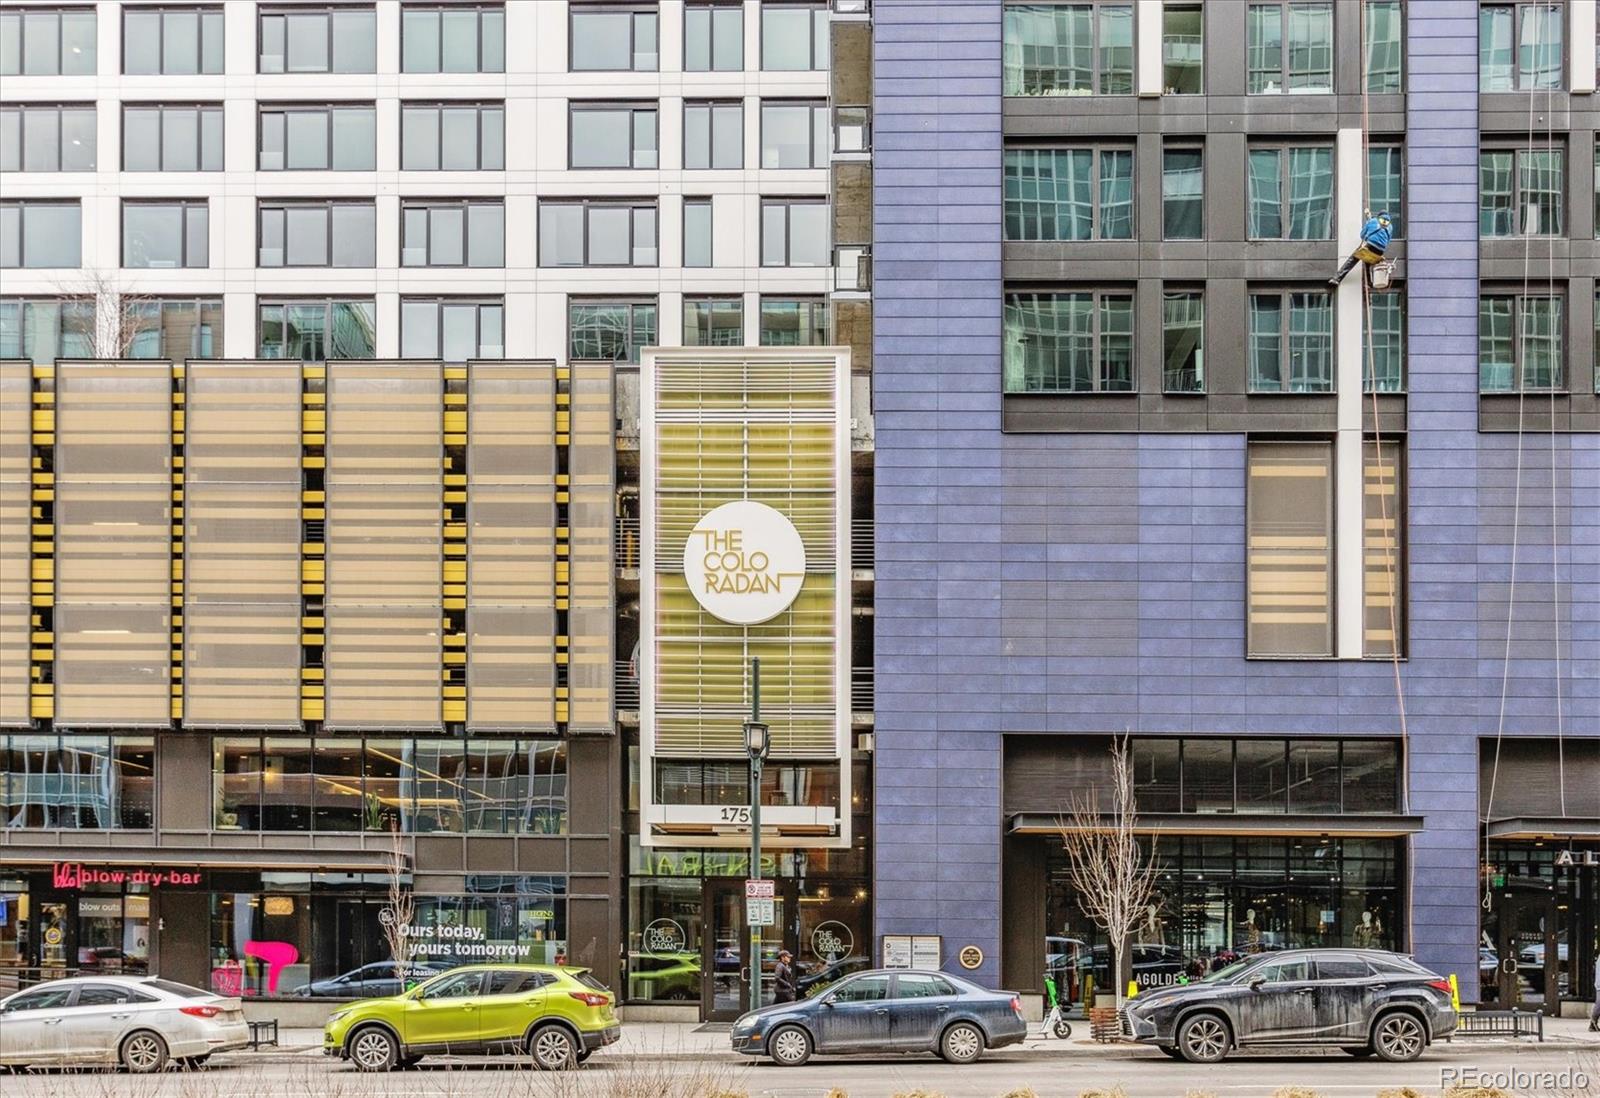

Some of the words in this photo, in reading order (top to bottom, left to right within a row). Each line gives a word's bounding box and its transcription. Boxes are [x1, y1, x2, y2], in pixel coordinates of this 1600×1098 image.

[692, 530, 743, 552] THE
[703, 551, 769, 572] COLO
[703, 572, 804, 594] RADAN
[721, 807, 754, 823] 175
[79, 902, 101, 911] blow
[102, 903, 121, 911] outs
[398, 924, 434, 937] Ours
[437, 923, 485, 940] today,
[409, 943, 451, 957] yours
[455, 941, 531, 956] tomorrow
